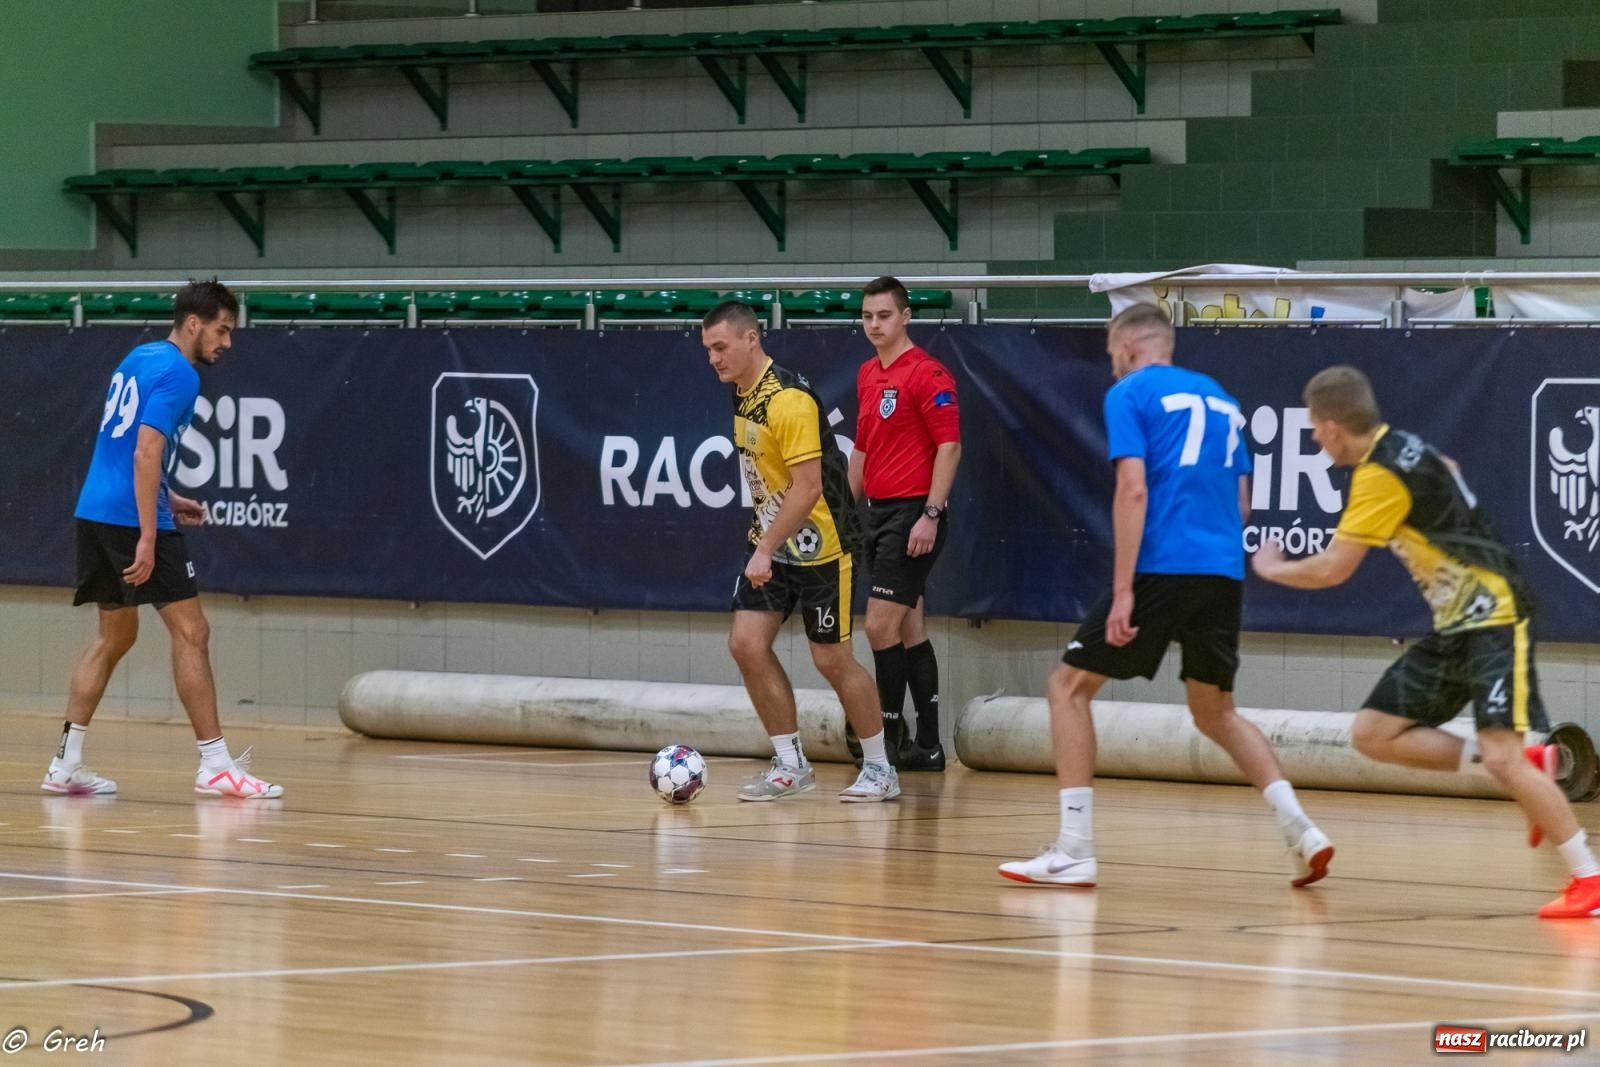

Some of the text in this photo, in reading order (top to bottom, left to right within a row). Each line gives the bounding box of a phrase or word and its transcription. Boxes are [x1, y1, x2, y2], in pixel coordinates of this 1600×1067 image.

[100, 372, 140, 439] 99
[1160, 392, 1239, 468] 77
[168, 395, 289, 491] SiR
[1239, 405, 1343, 514] iR
[201, 494, 289, 527] ACIBÓRZ
[815, 606, 835, 629] 16
[1488, 678, 1507, 706] 4
